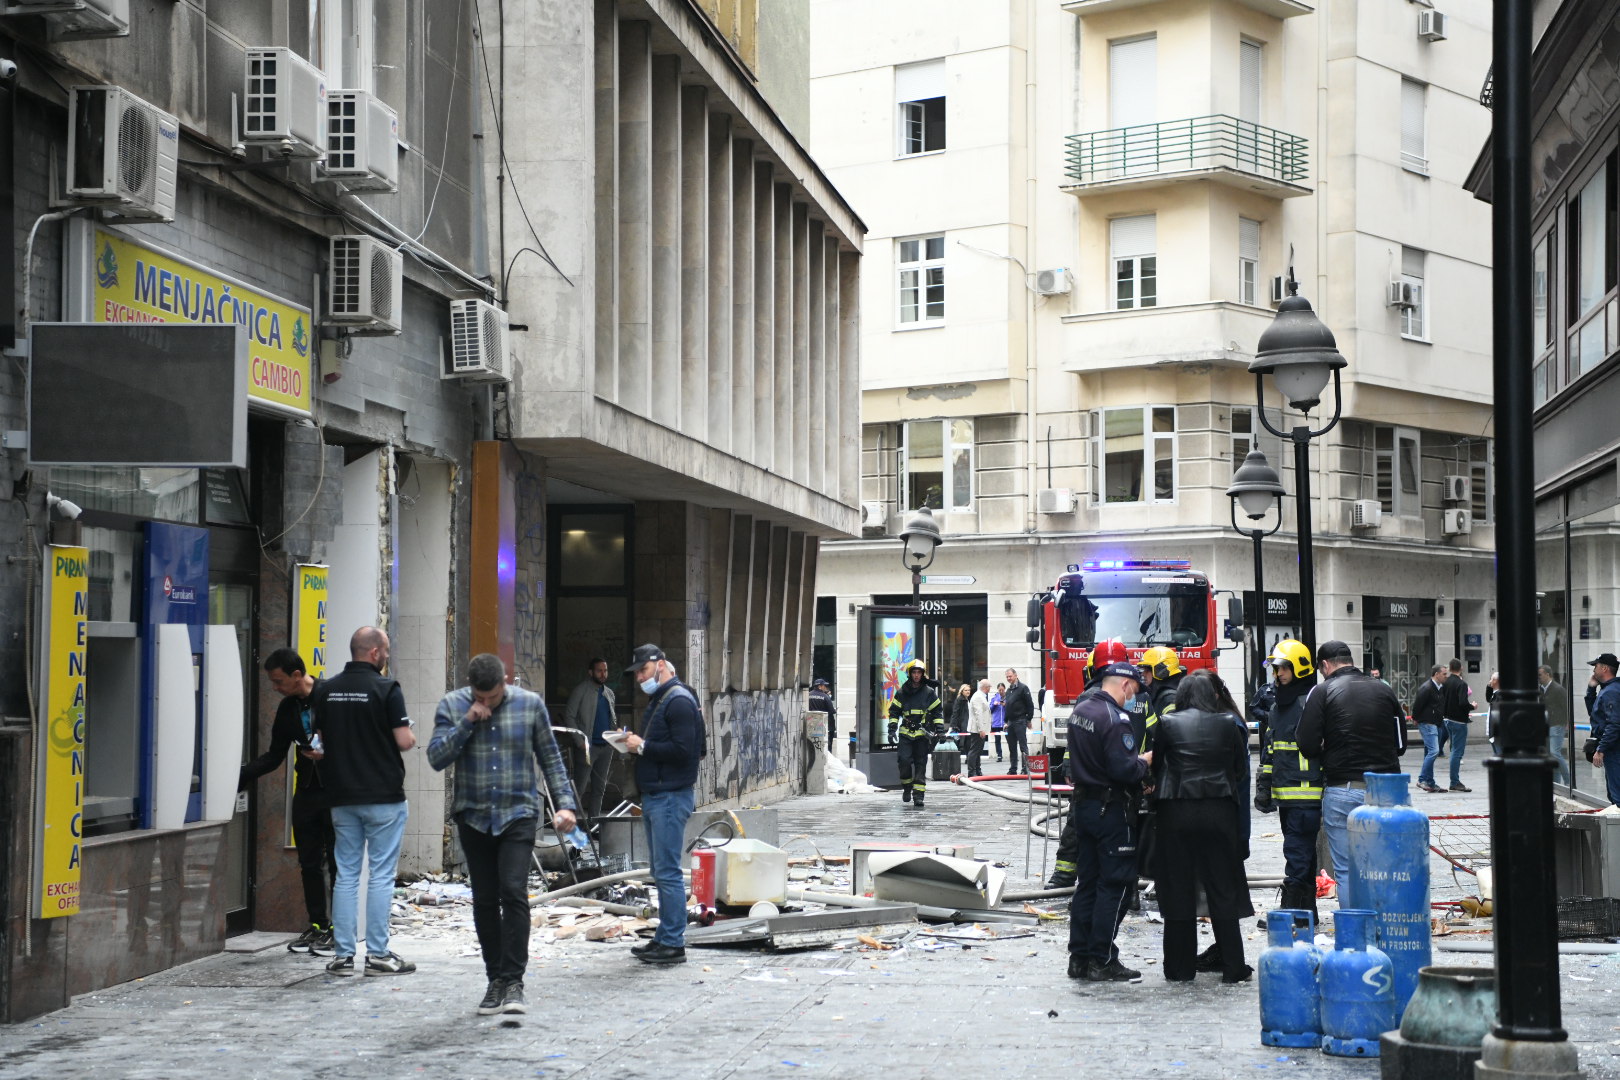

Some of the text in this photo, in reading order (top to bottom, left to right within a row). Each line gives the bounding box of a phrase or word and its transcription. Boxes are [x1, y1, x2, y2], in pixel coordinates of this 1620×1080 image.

[134, 259, 282, 351] MENJAČNICA
[252, 356, 302, 398] CAMBIO
[1267, 598, 1288, 610] BOSS
[1390, 602, 1408, 614] BOSS
[1386, 926, 1409, 937] IZVAN
